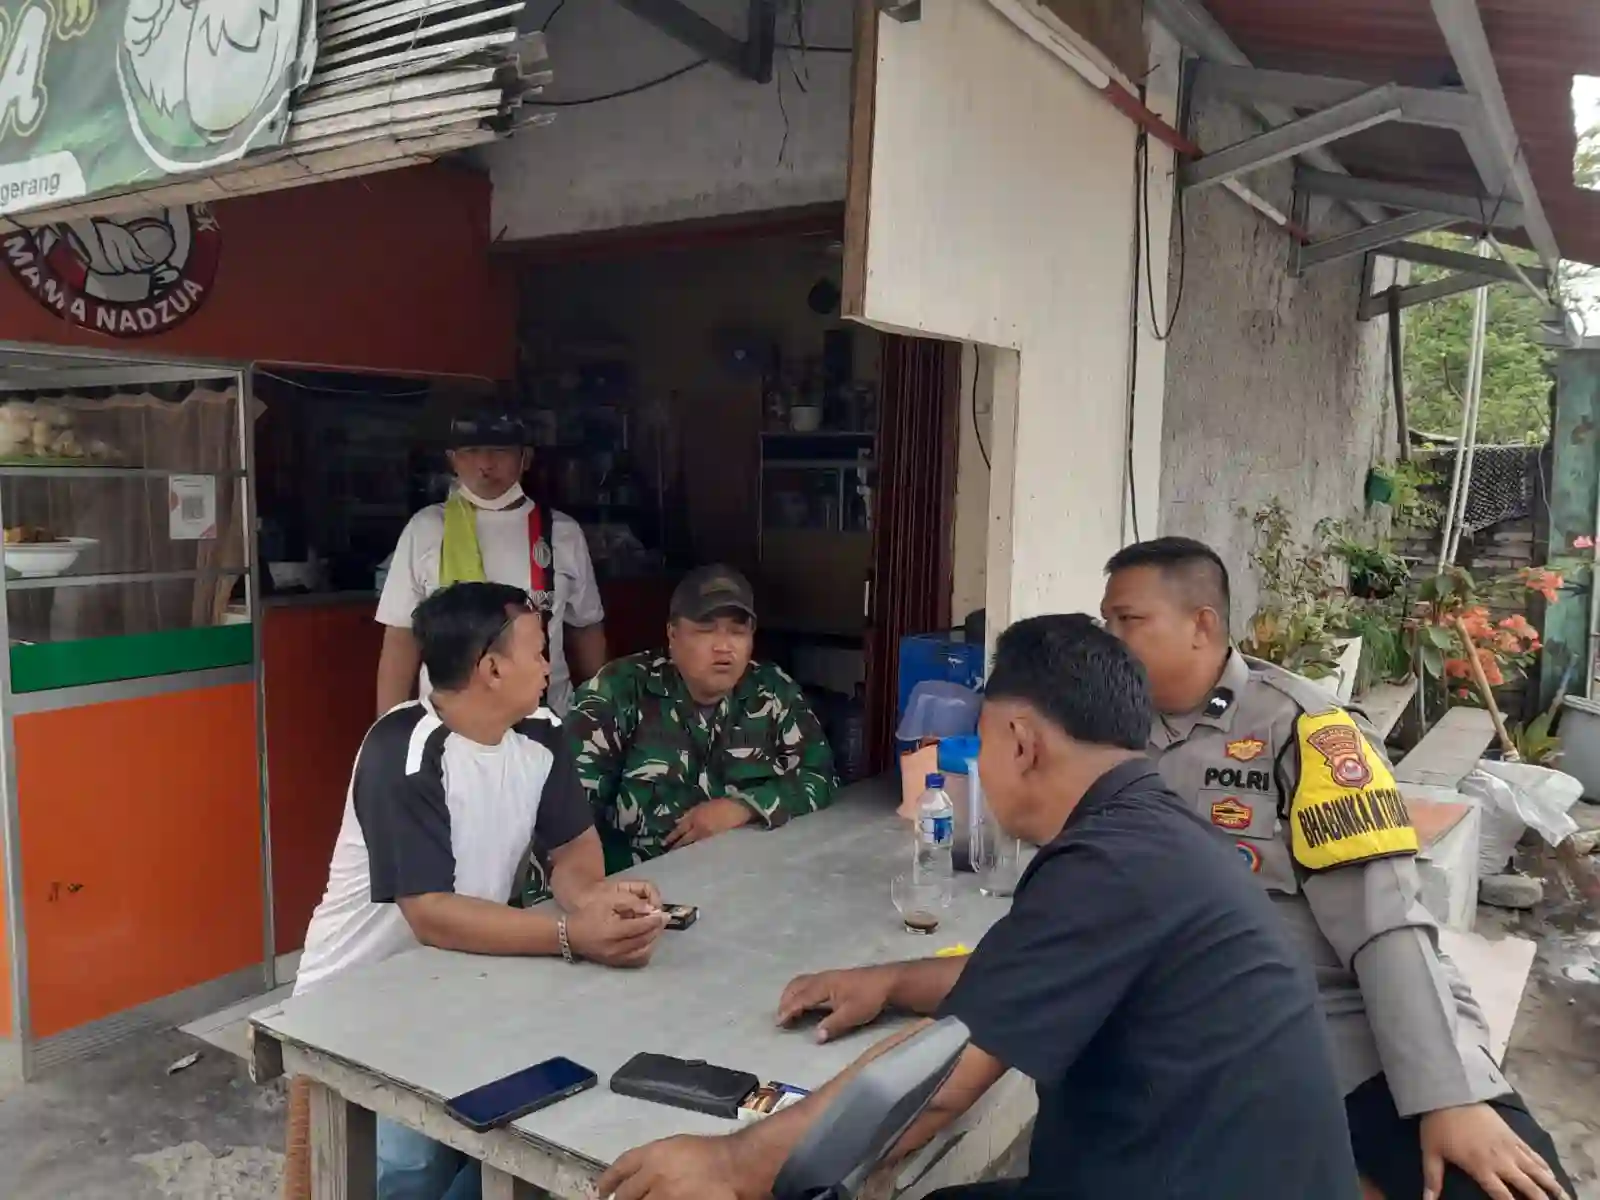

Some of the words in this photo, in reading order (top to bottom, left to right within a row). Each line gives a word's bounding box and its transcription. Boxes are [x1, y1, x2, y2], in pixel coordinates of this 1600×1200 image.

[3, 236, 86, 322] MAMA
[96, 279, 203, 332] NADZUA
[1204, 767, 1270, 791] POLRI
